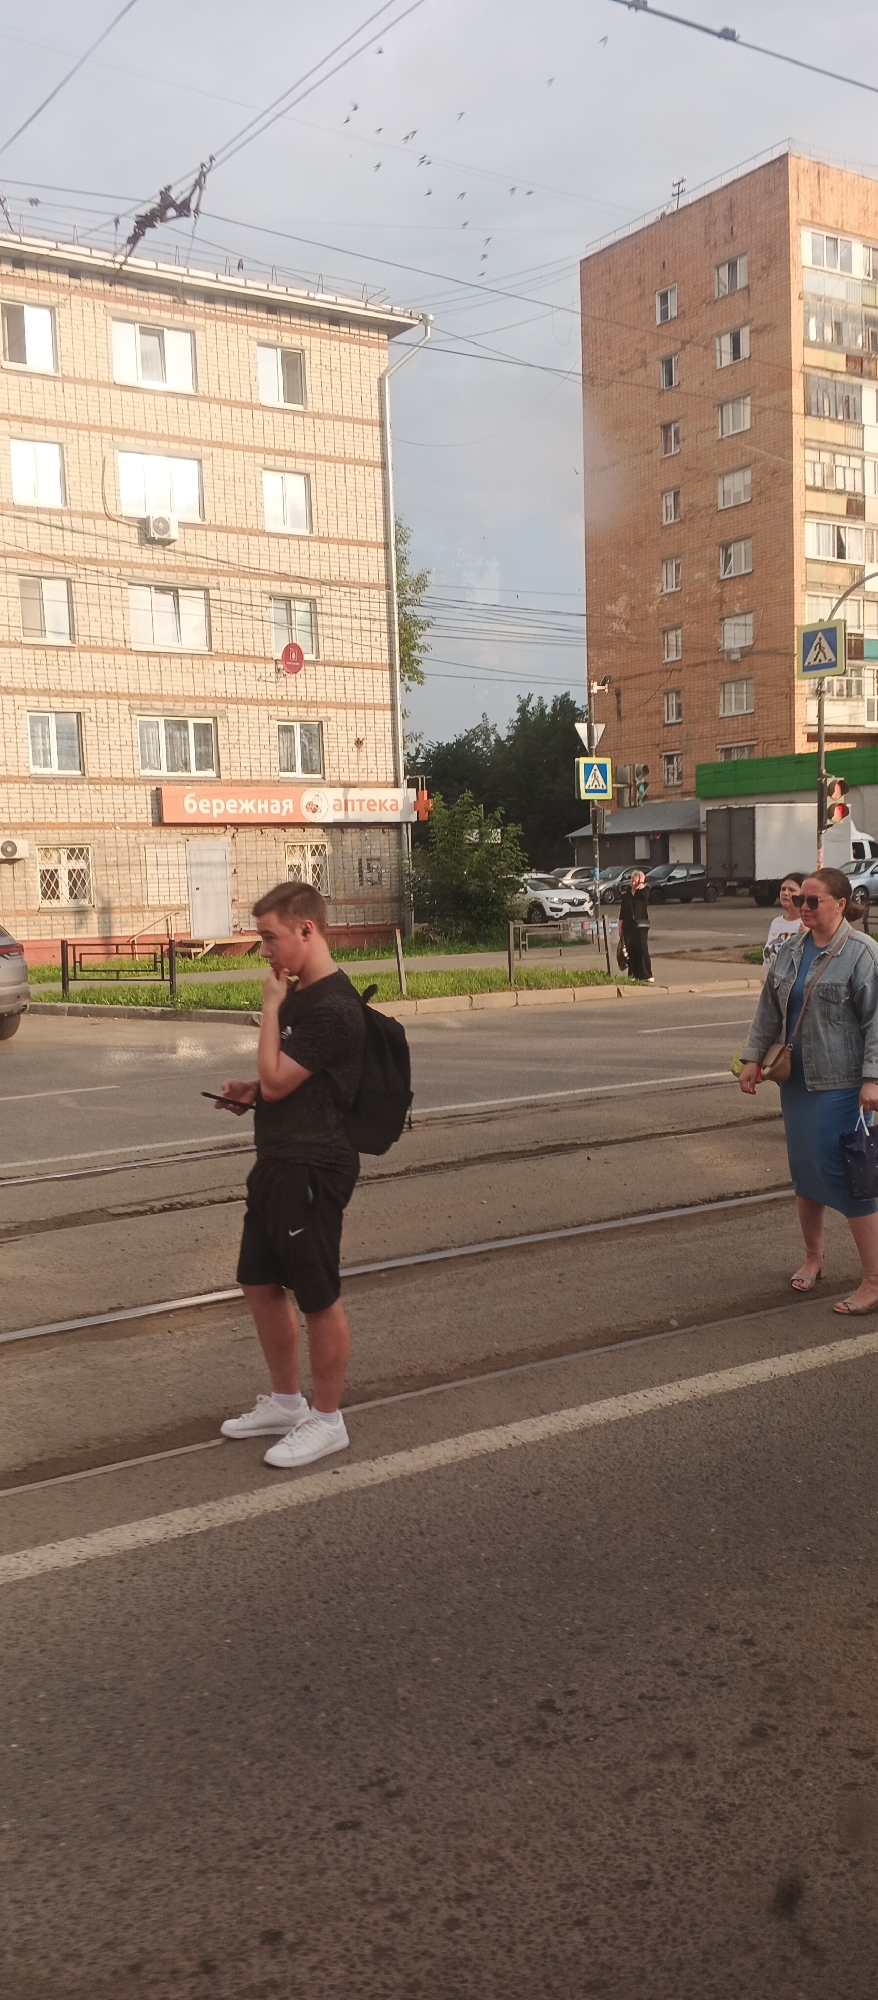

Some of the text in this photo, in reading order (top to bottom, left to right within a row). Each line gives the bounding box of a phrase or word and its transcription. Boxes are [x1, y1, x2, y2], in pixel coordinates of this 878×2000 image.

[183, 792, 399, 818] бережная аптека
[357, 857, 383, 886] 15
